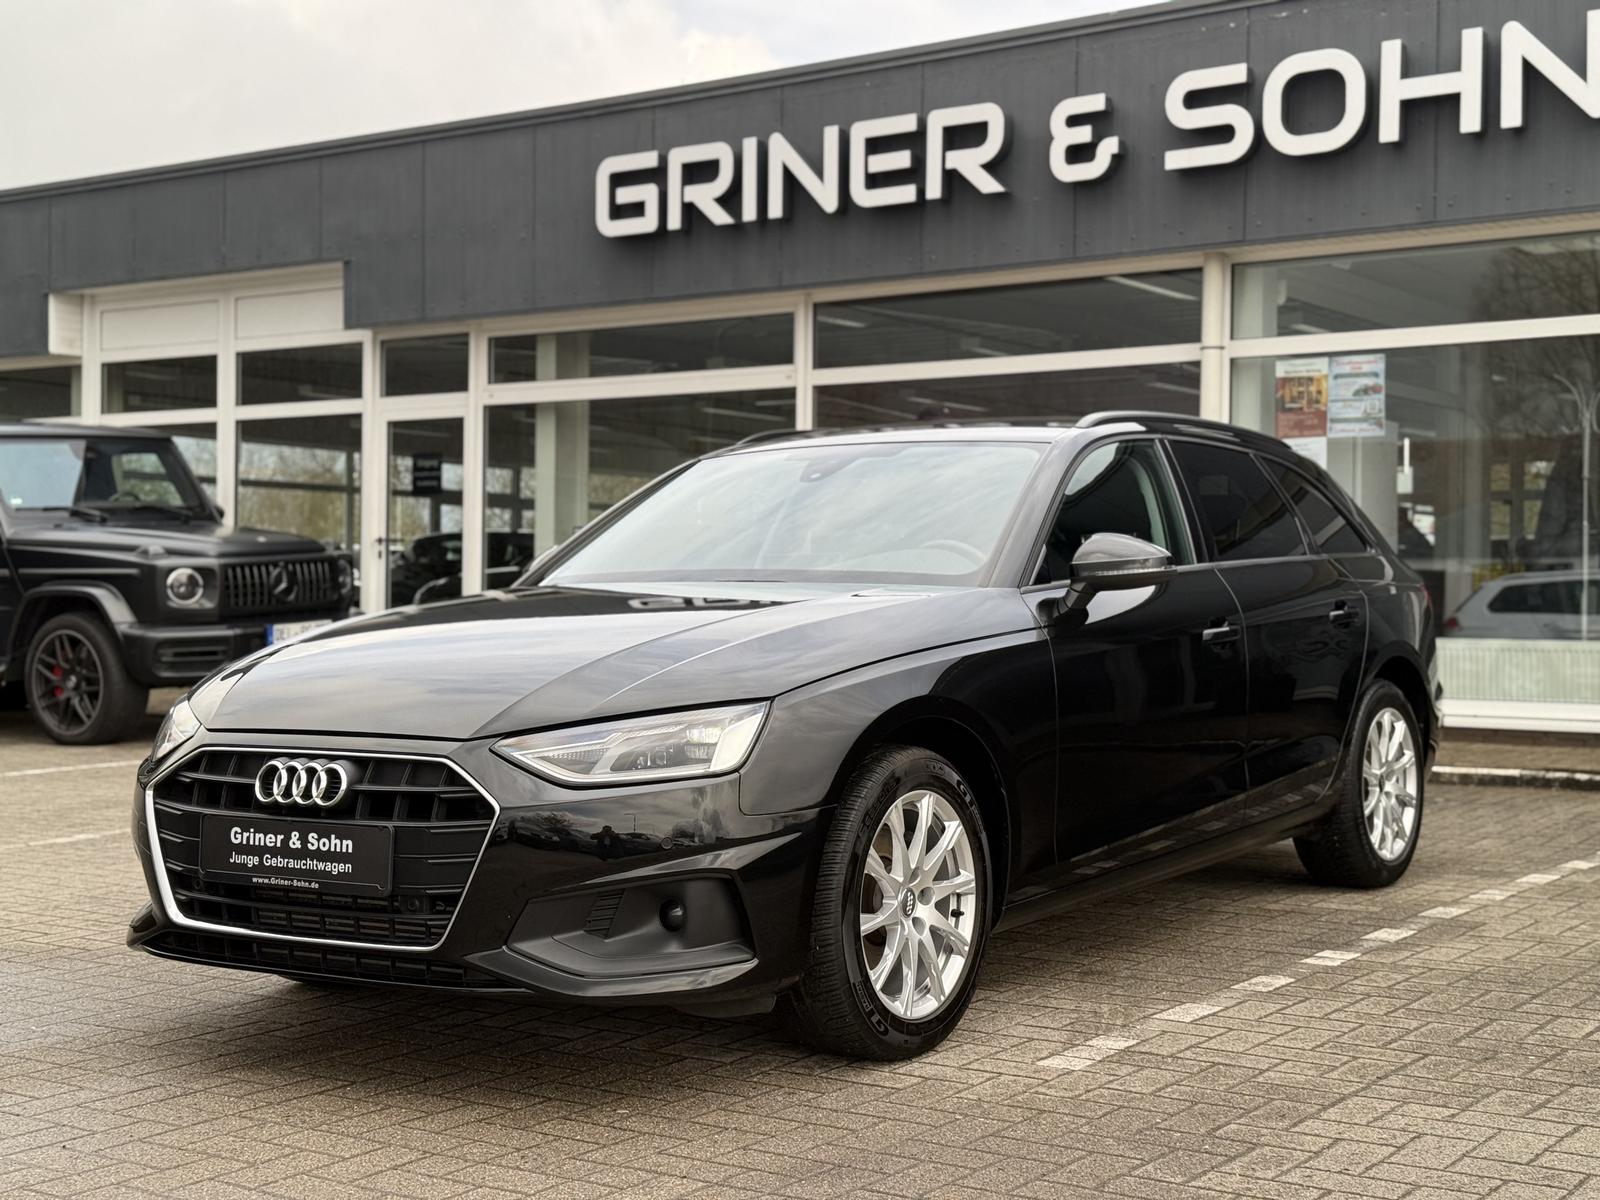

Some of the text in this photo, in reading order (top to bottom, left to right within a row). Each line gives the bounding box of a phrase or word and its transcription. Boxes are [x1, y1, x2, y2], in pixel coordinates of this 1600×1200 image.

[595, 8, 1600, 238] GRINER & SOHN
[229, 826, 353, 853] Griner & Sohn
[229, 851, 353, 875] Junge Gebrauchtwagen
[252, 876, 320, 889] www.Griner-Sohn.de
